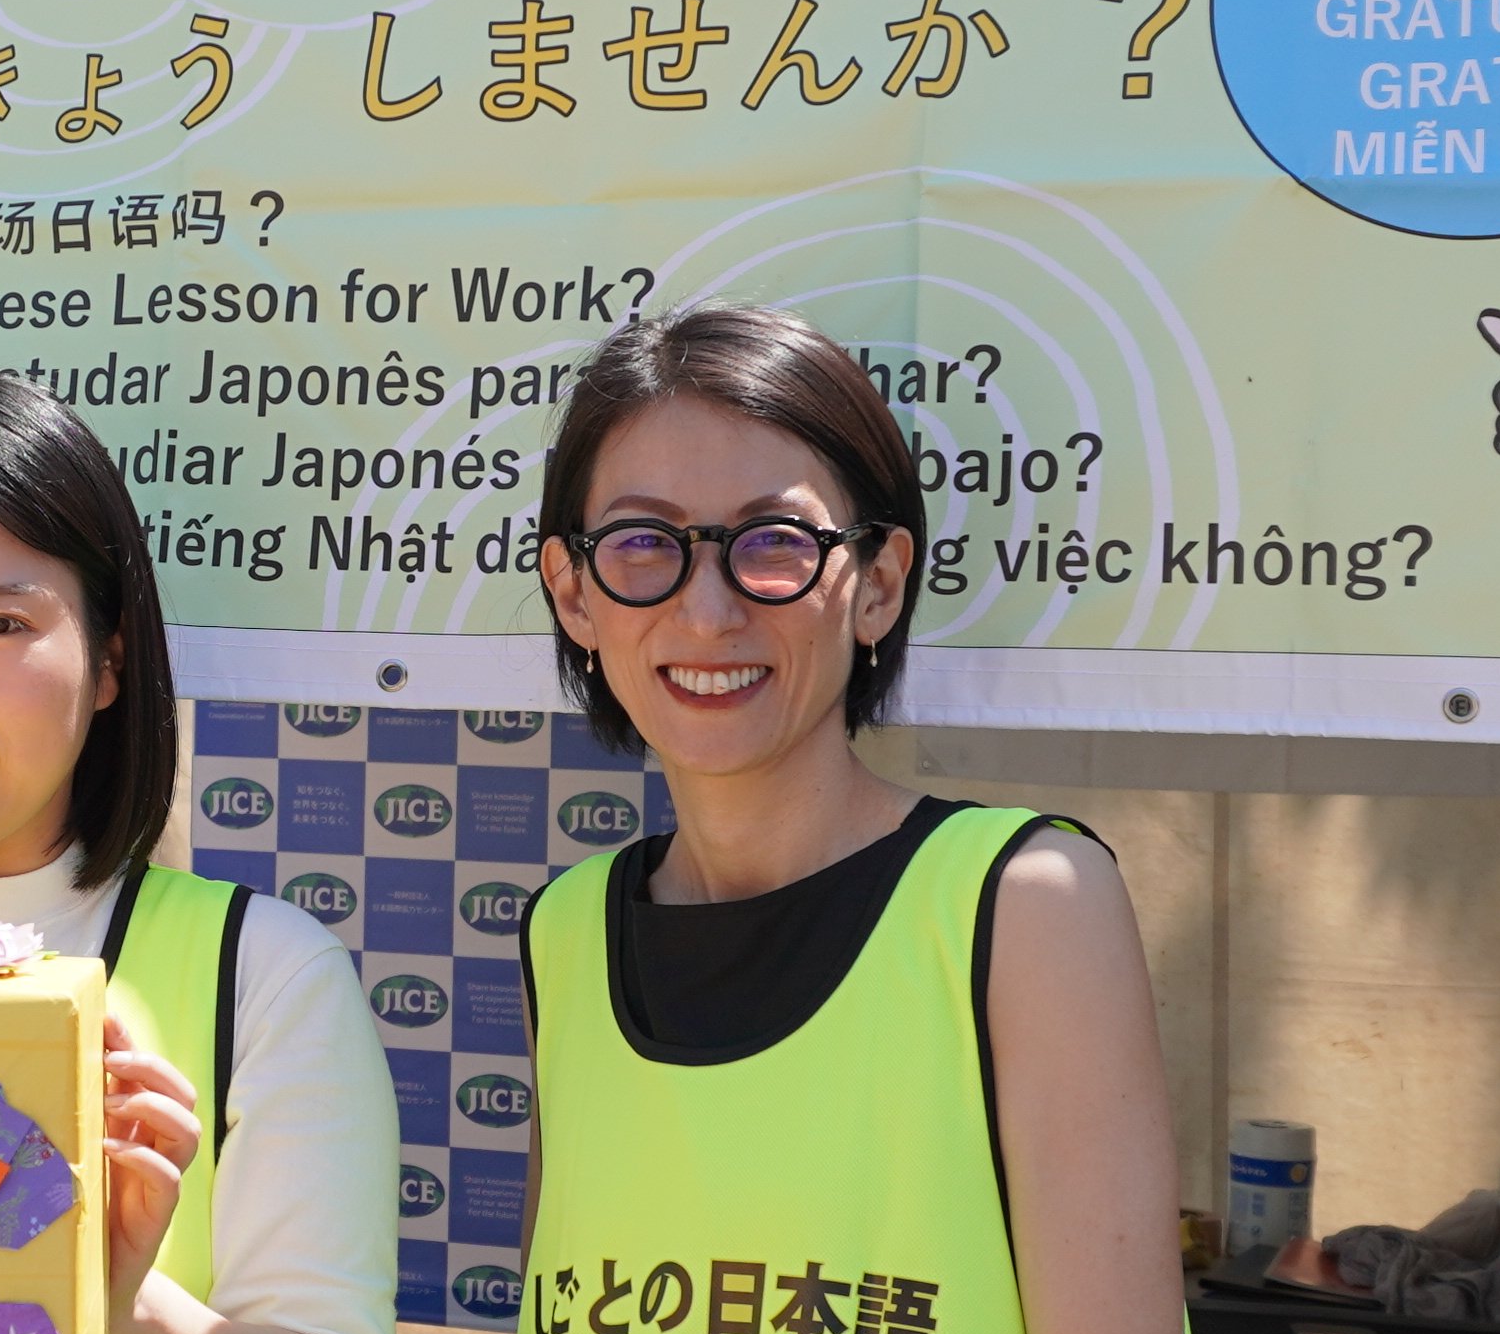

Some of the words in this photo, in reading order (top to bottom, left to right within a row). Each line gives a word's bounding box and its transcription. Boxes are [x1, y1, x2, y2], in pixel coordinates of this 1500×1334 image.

[1334, 120, 1485, 176] MIỄN
[113, 271, 319, 327] Lesson
[341, 267, 428, 324] for
[452, 266, 655, 325] Work?
[189, 350, 445, 417] Japonês
[262, 433, 520, 500] Japonés
[309, 516, 454, 583] Nhật
[993, 523, 1133, 595] việc
[1161, 523, 1434, 601] không?
[210, 791, 266, 818] JICE
[384, 799, 444, 826] JICE
[568, 805, 630, 834] JICE
[380, 988, 440, 1015] JICE
[466, 1087, 528, 1116] JICE
[400, 1178, 437, 1204] CE
[463, 1278, 523, 1306] JICE
